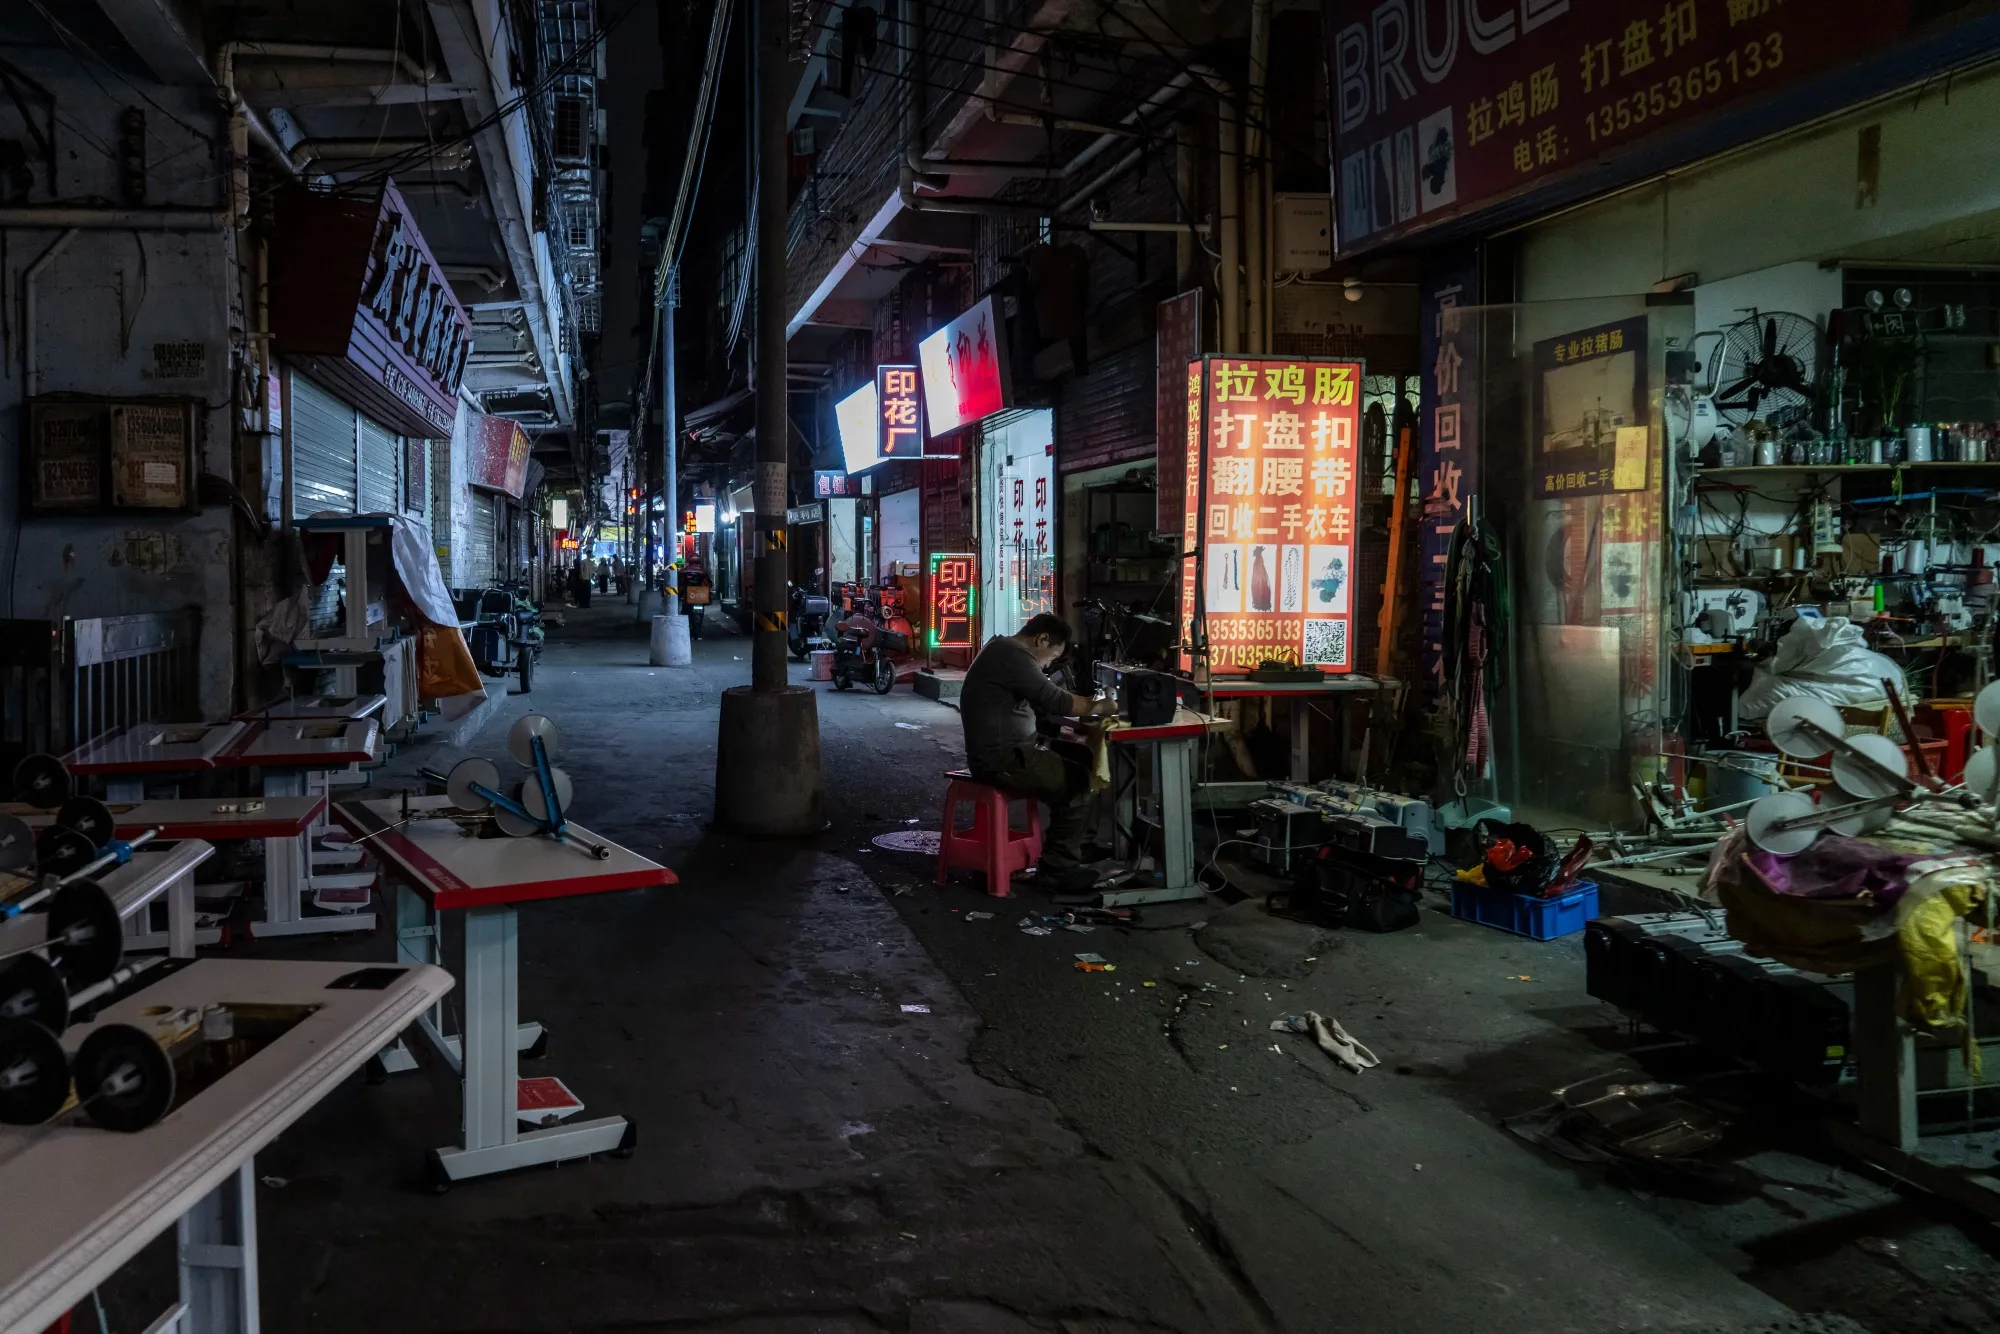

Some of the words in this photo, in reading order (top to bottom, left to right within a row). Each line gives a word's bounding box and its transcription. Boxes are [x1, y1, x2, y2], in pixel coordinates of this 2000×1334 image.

[1467, 62, 1560, 147] 拉鸡肠
[1579, 0, 1698, 94] 打盘扣
[1585, 31, 1784, 142] 13535365133
[1554, 329, 1624, 362] 专业拉猪肠
[884, 369, 917, 454] 印花厂
[1215, 363, 1354, 406] 拉鸡肠
[1186, 374, 1201, 497] 鸿悦针车行
[1212, 408, 1352, 451] 打盘扣
[1035, 476, 1048, 554] 印花
[1210, 455, 1352, 498] 翻腰带
[1014, 477, 1024, 554] 印花
[1208, 503, 1351, 541] 回收二手衣车
[937, 560, 968, 642] 印花厂
[1206, 619, 1300, 640] 13535365133
